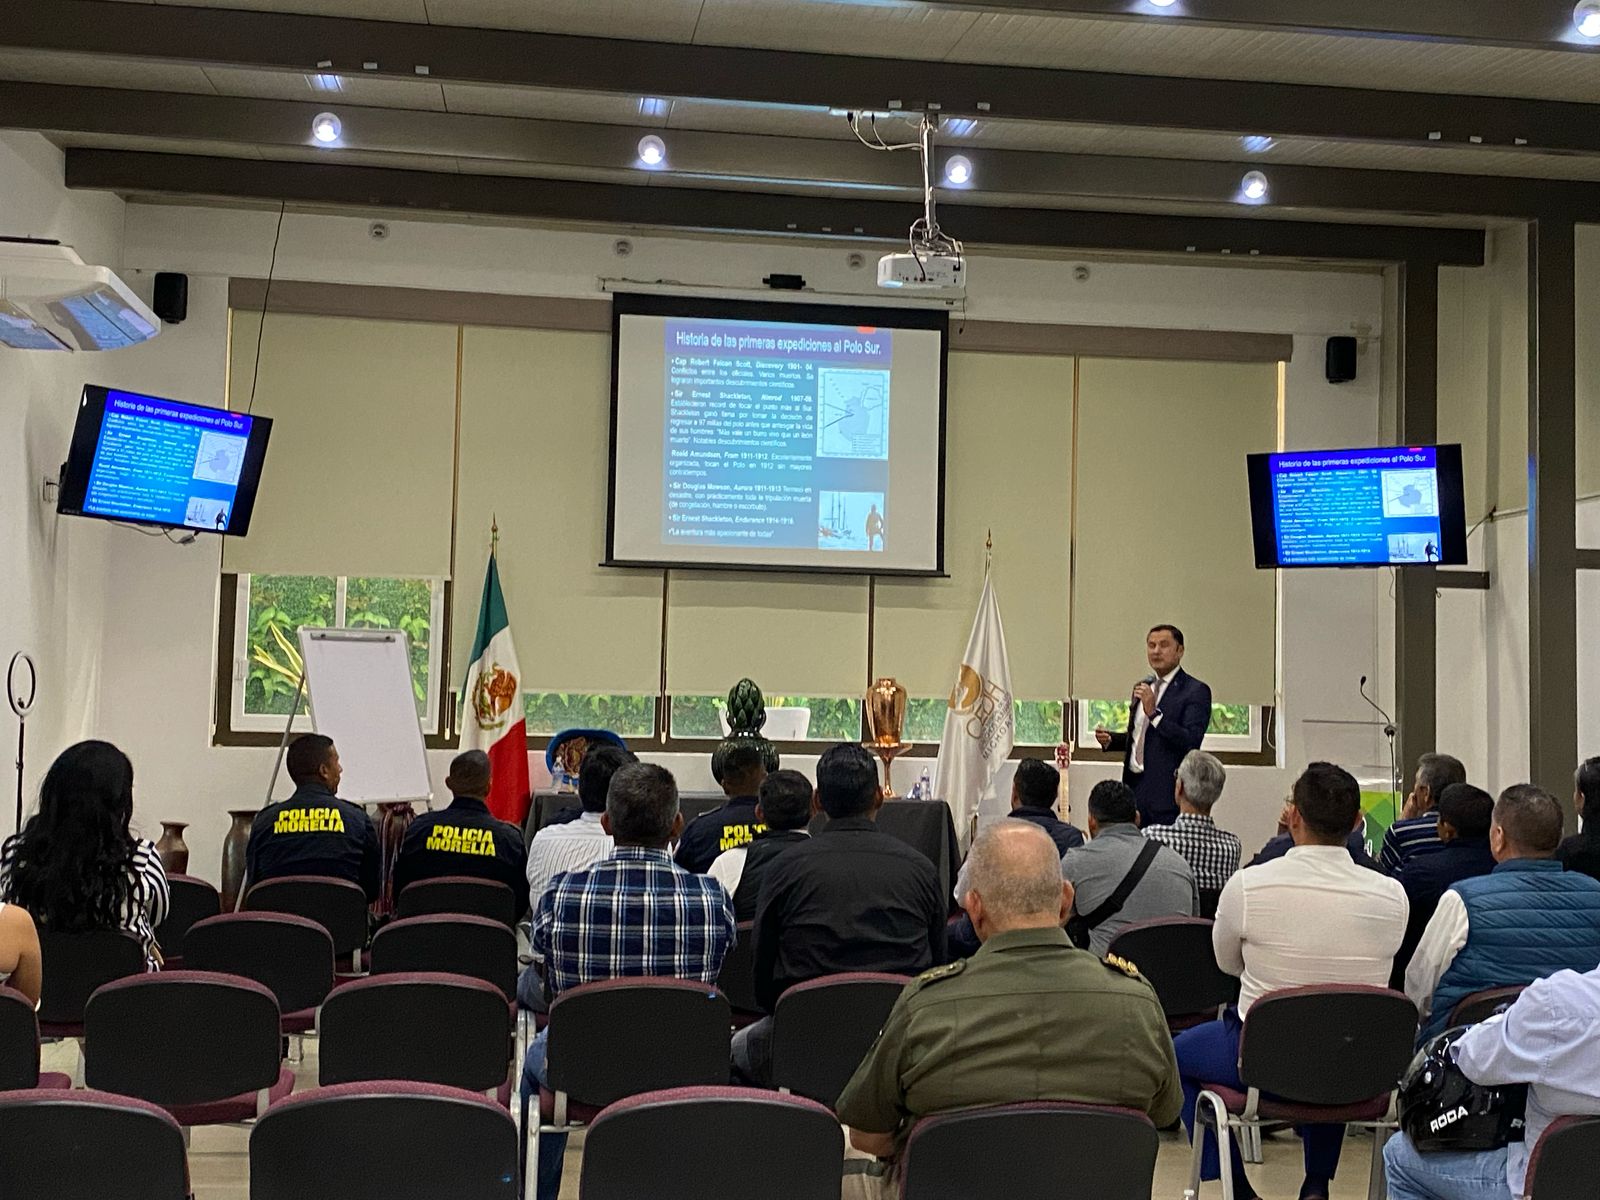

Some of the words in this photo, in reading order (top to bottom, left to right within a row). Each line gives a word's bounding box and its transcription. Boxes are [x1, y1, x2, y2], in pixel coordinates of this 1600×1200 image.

[676, 331, 709, 346] Historia
[710, 332, 722, 347] de
[724, 333, 737, 348] las
[739, 335, 776, 351] primeras
[777, 338, 832, 354] expediciones
[834, 339, 841, 352] al
[844, 339, 862, 354] Polo
[864, 341, 881, 355] Sur.
[690, 358, 710, 366] Robert
[692, 390, 711, 398] Ernest
[114, 399, 136, 411] Historia
[136, 403, 145, 412] de
[145, 405, 154, 414] las
[154, 406, 179, 418] primeras
[179, 411, 214, 424] expediciones
[214, 417, 220, 426] al
[220, 418, 233, 428] Polo
[1278, 460, 1302, 468] Historia
[1312, 459, 1322, 467] las
[1322, 458, 1349, 467] primeras
[1350, 456, 1391, 466] expediciones
[1399, 455, 1414, 463] Polo
[278, 807, 341, 821] POLICIA
[273, 819, 345, 834] MORELIA
[432, 824, 493, 843] POLICIA
[426, 836, 496, 857] MORELIA
[1430, 1105, 1469, 1133] RODA
